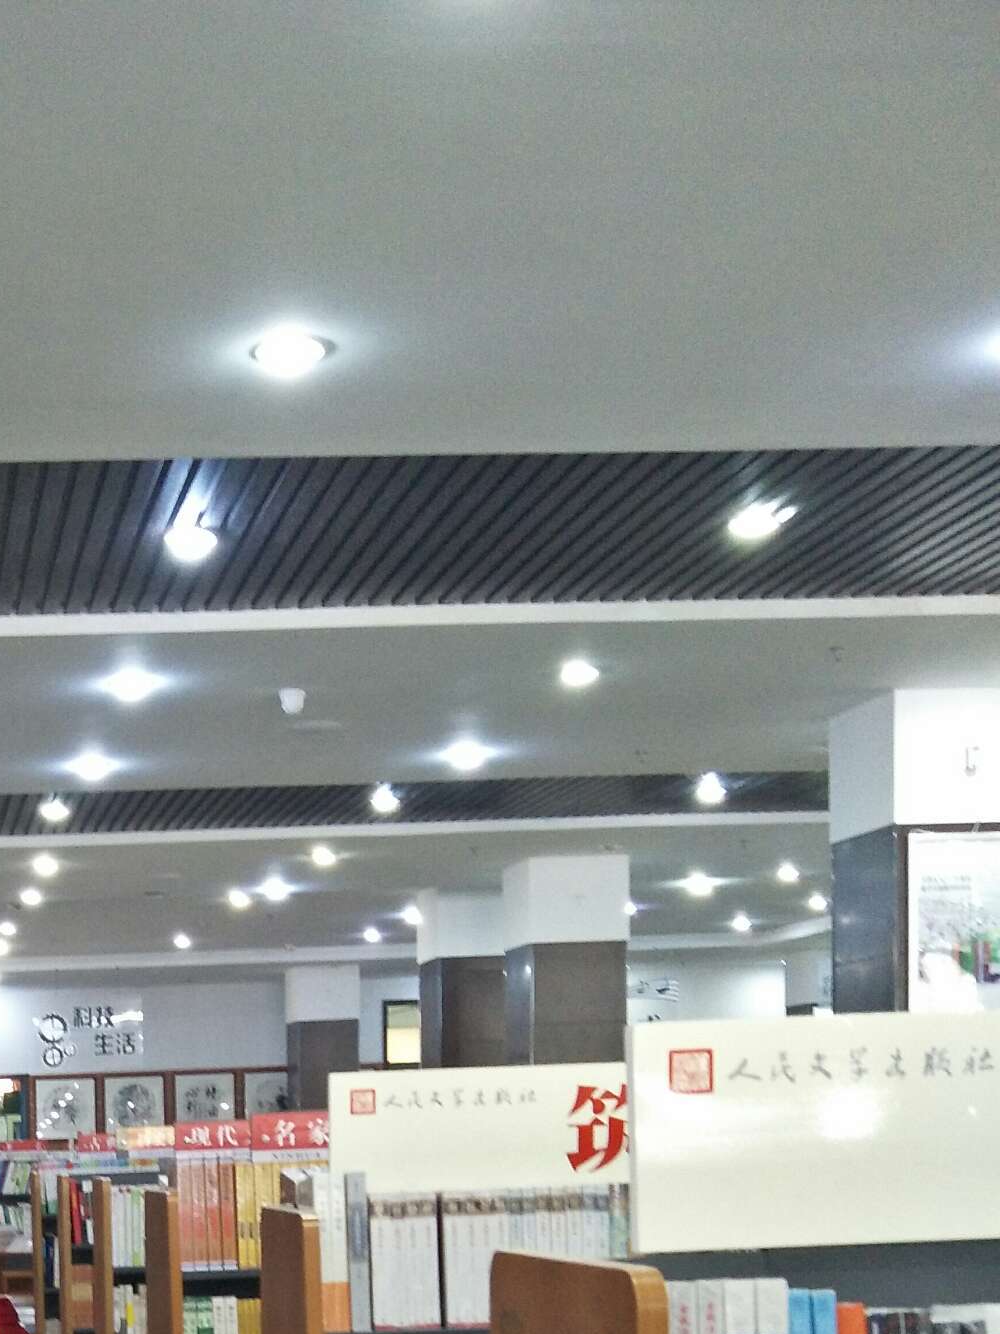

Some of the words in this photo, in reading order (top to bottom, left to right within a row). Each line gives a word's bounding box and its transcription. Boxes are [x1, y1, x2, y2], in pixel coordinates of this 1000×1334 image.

[73, 1006, 114, 1028] 科技
[95, 1032, 135, 1056] 生活
[728, 1046, 994, 1083] 人民文学出版社
